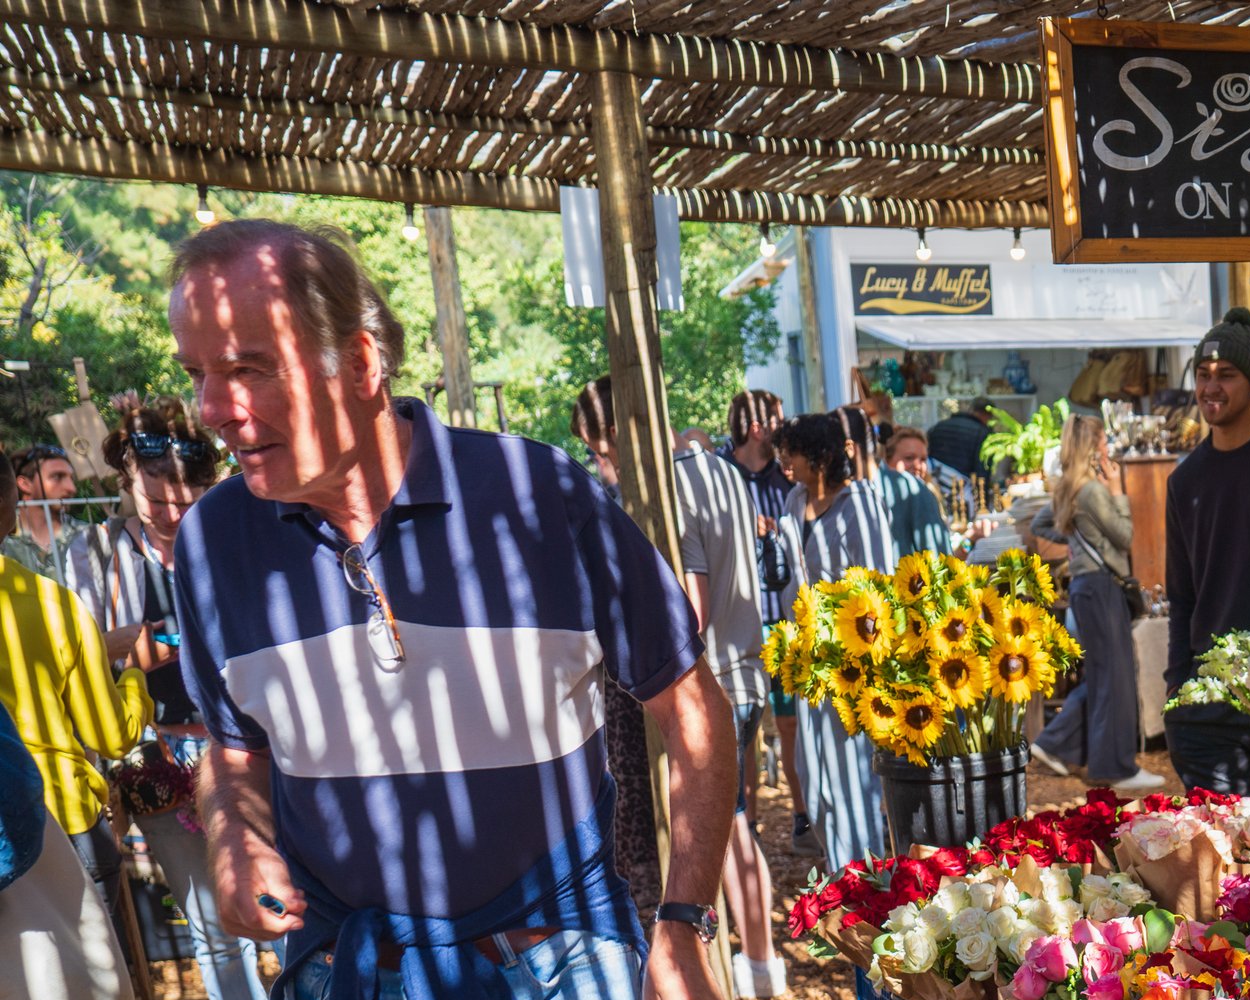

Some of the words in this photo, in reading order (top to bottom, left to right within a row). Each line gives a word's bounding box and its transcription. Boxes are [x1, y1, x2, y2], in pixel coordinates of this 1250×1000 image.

[1175, 182, 1233, 219] ON
[860, 266, 908, 300] Lucy
[911, 267, 928, 292] &
[928, 267, 988, 298] Muffet
